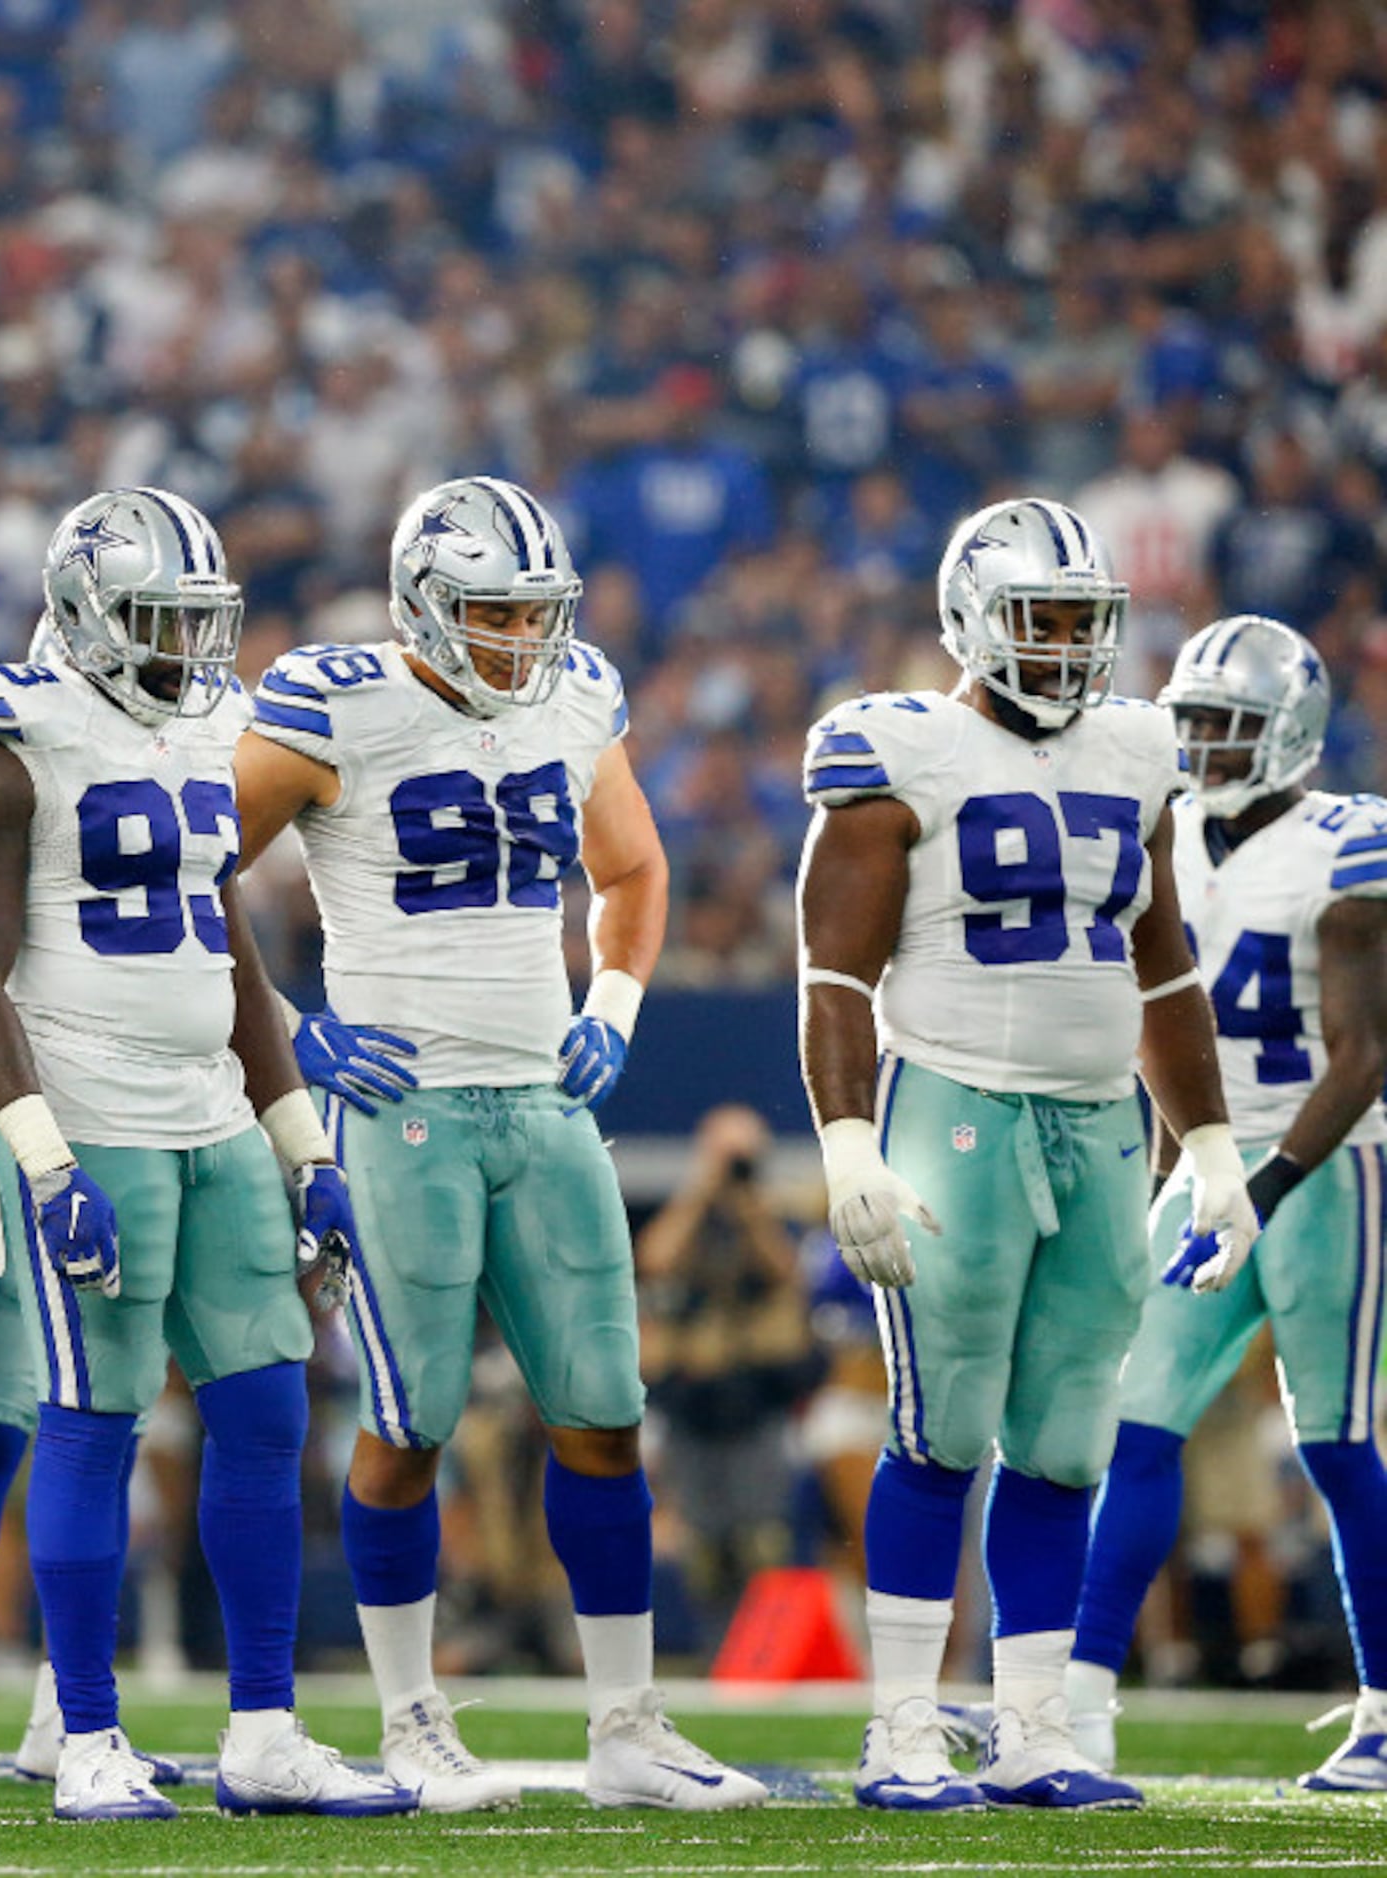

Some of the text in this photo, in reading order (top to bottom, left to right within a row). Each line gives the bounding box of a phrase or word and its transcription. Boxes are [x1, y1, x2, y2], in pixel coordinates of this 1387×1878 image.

[76, 778, 243, 956] 93
[389, 759, 578, 916] 98
[956, 791, 1145, 967] 97
[1183, 921, 1314, 1084] 4
